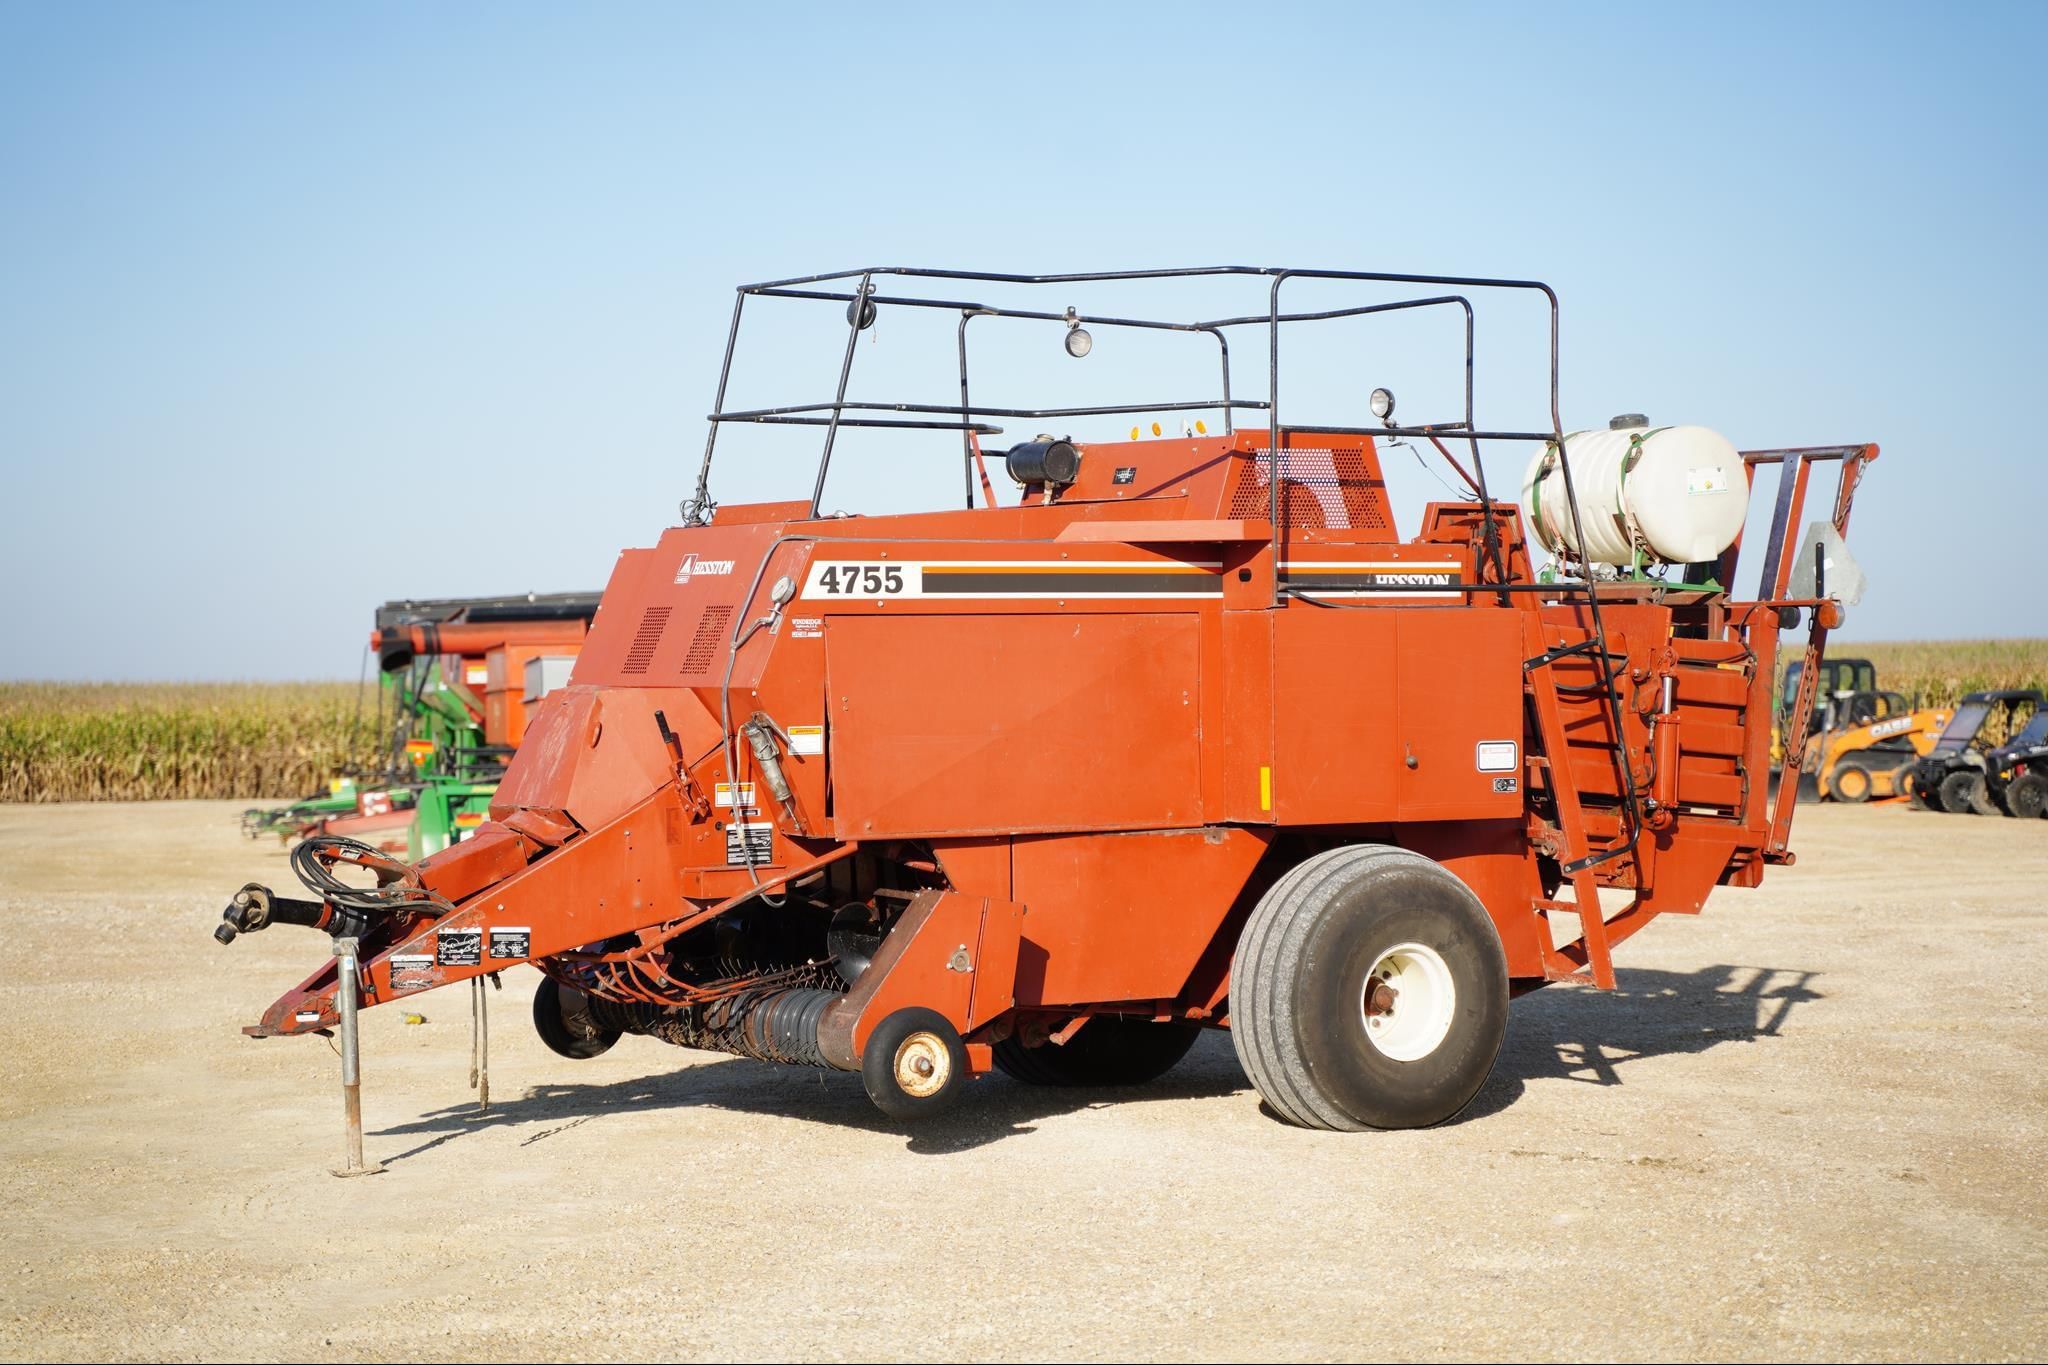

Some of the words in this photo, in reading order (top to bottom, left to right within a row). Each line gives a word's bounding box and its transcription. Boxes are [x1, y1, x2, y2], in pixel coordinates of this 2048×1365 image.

[692, 561, 733, 575] HESSTON
[819, 565, 904, 594] 4755
[1871, 717, 1912, 738] CASE
